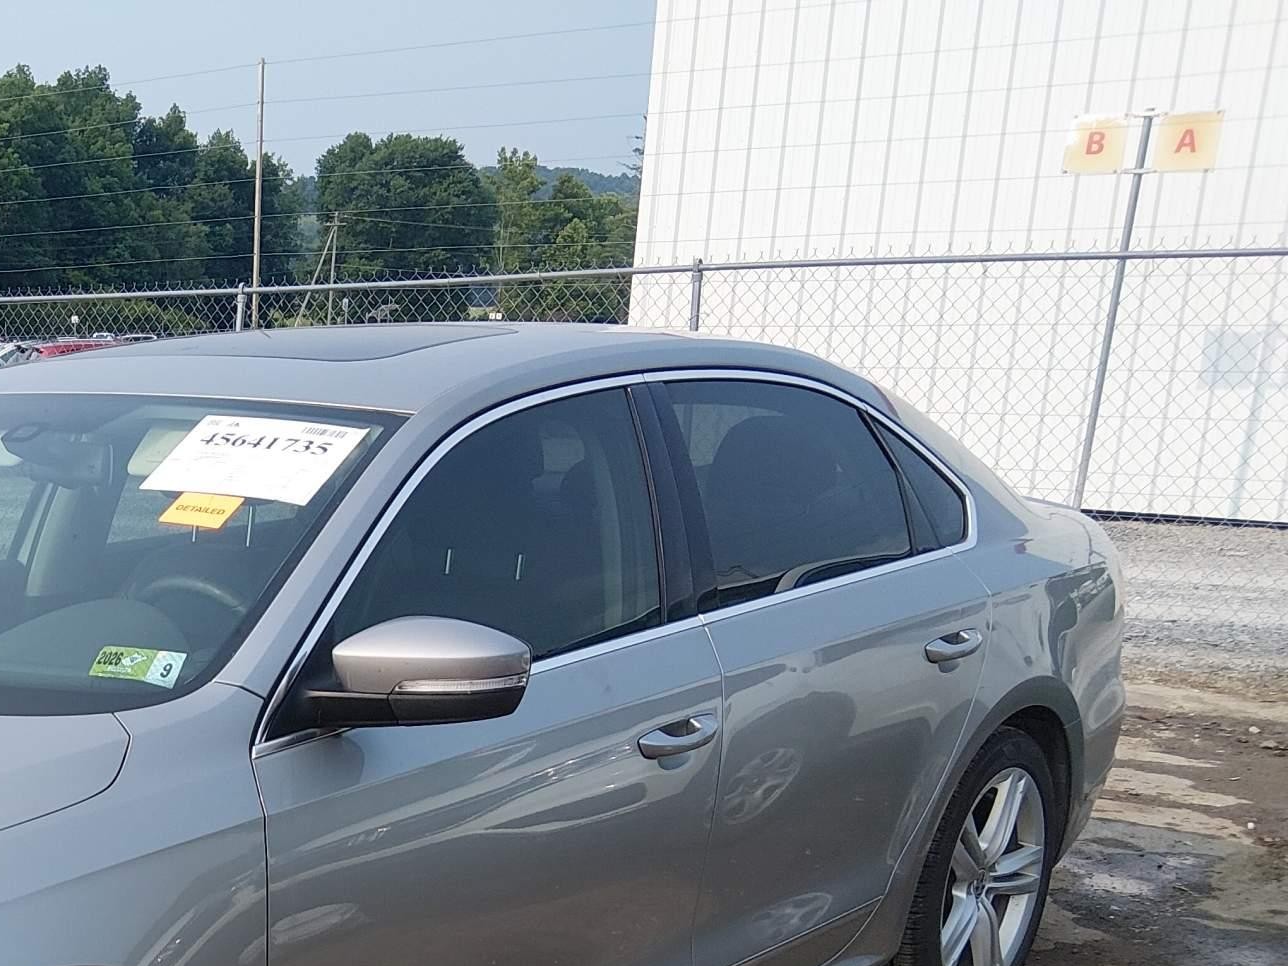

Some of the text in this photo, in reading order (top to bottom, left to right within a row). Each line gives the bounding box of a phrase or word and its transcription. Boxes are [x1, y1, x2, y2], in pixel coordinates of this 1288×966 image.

[1085, 131, 1106, 155] B
[1174, 129, 1197, 154] A
[200, 432, 333, 456] 45641735
[175, 503, 226, 515] DETAILED
[96, 651, 124, 666] 2026
[159, 662, 174, 679] 9
